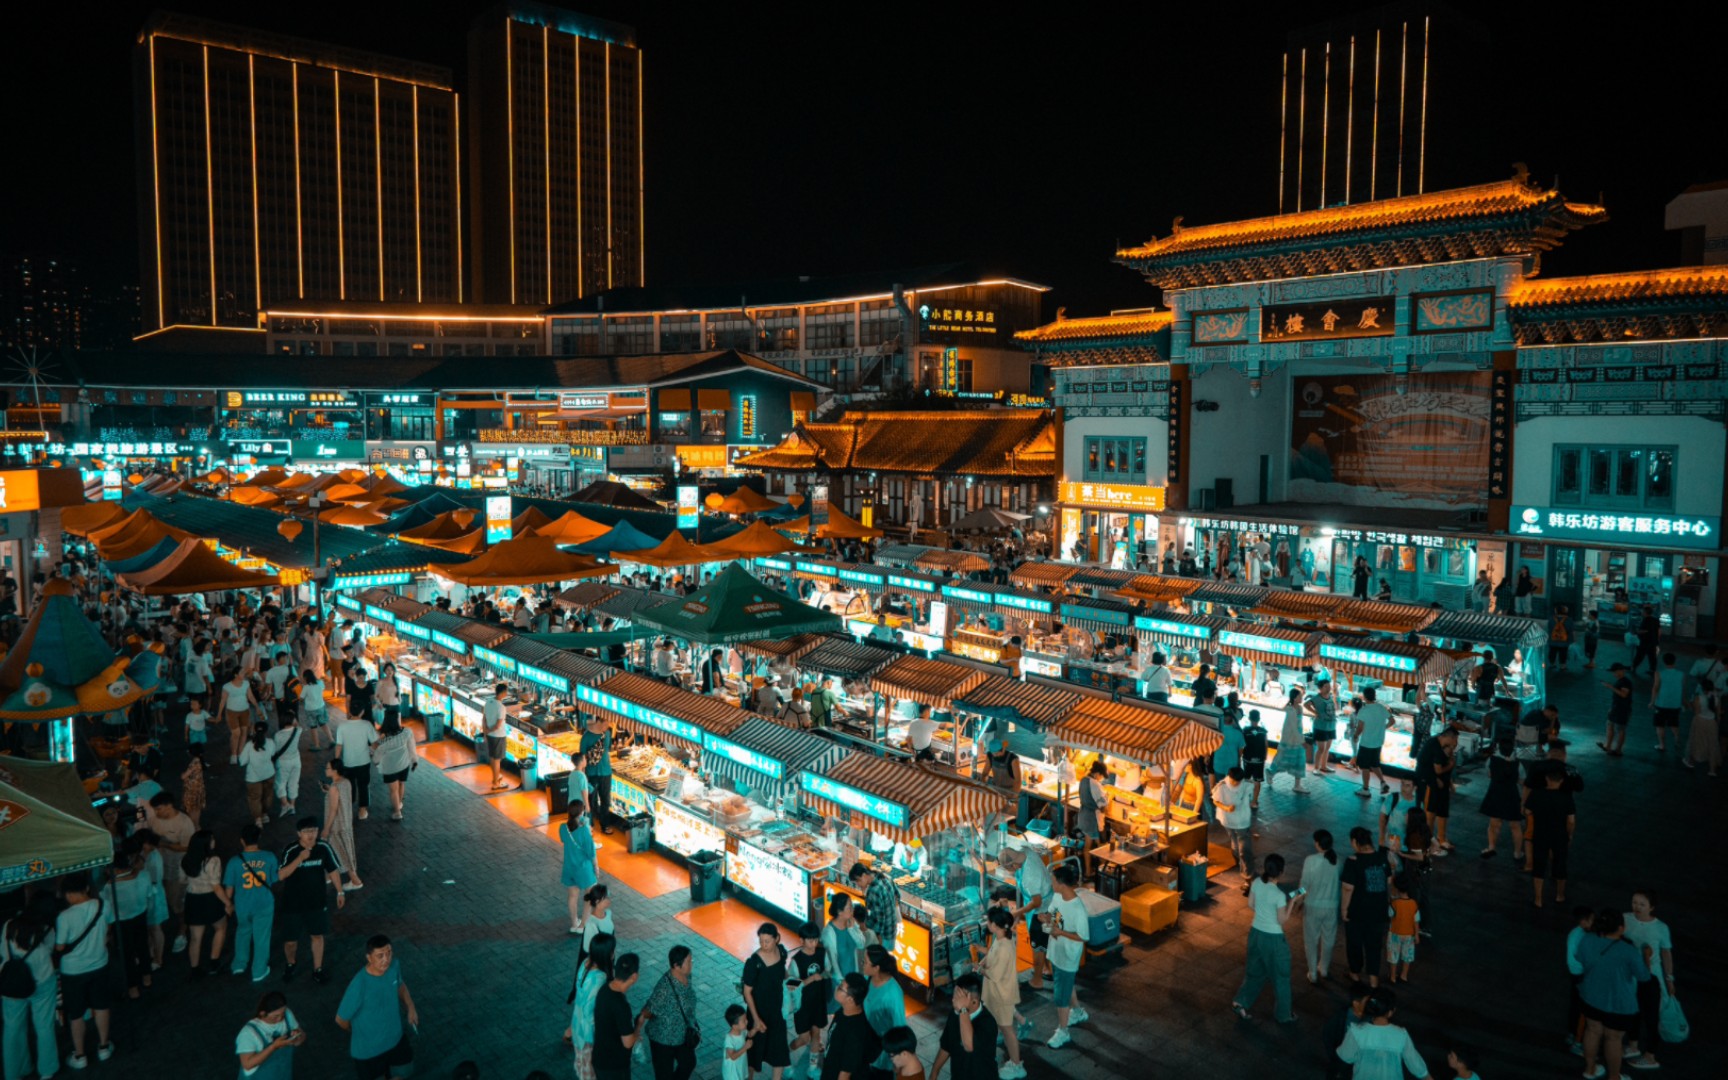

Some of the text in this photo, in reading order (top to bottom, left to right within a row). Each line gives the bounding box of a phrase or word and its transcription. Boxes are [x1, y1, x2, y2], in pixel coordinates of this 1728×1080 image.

[246, 392, 275, 401] BEER
[277, 392, 306, 401] KING
[1548, 513, 1711, 536] 韩乐坊游客服务中心
[242, 870, 267, 889] 30
